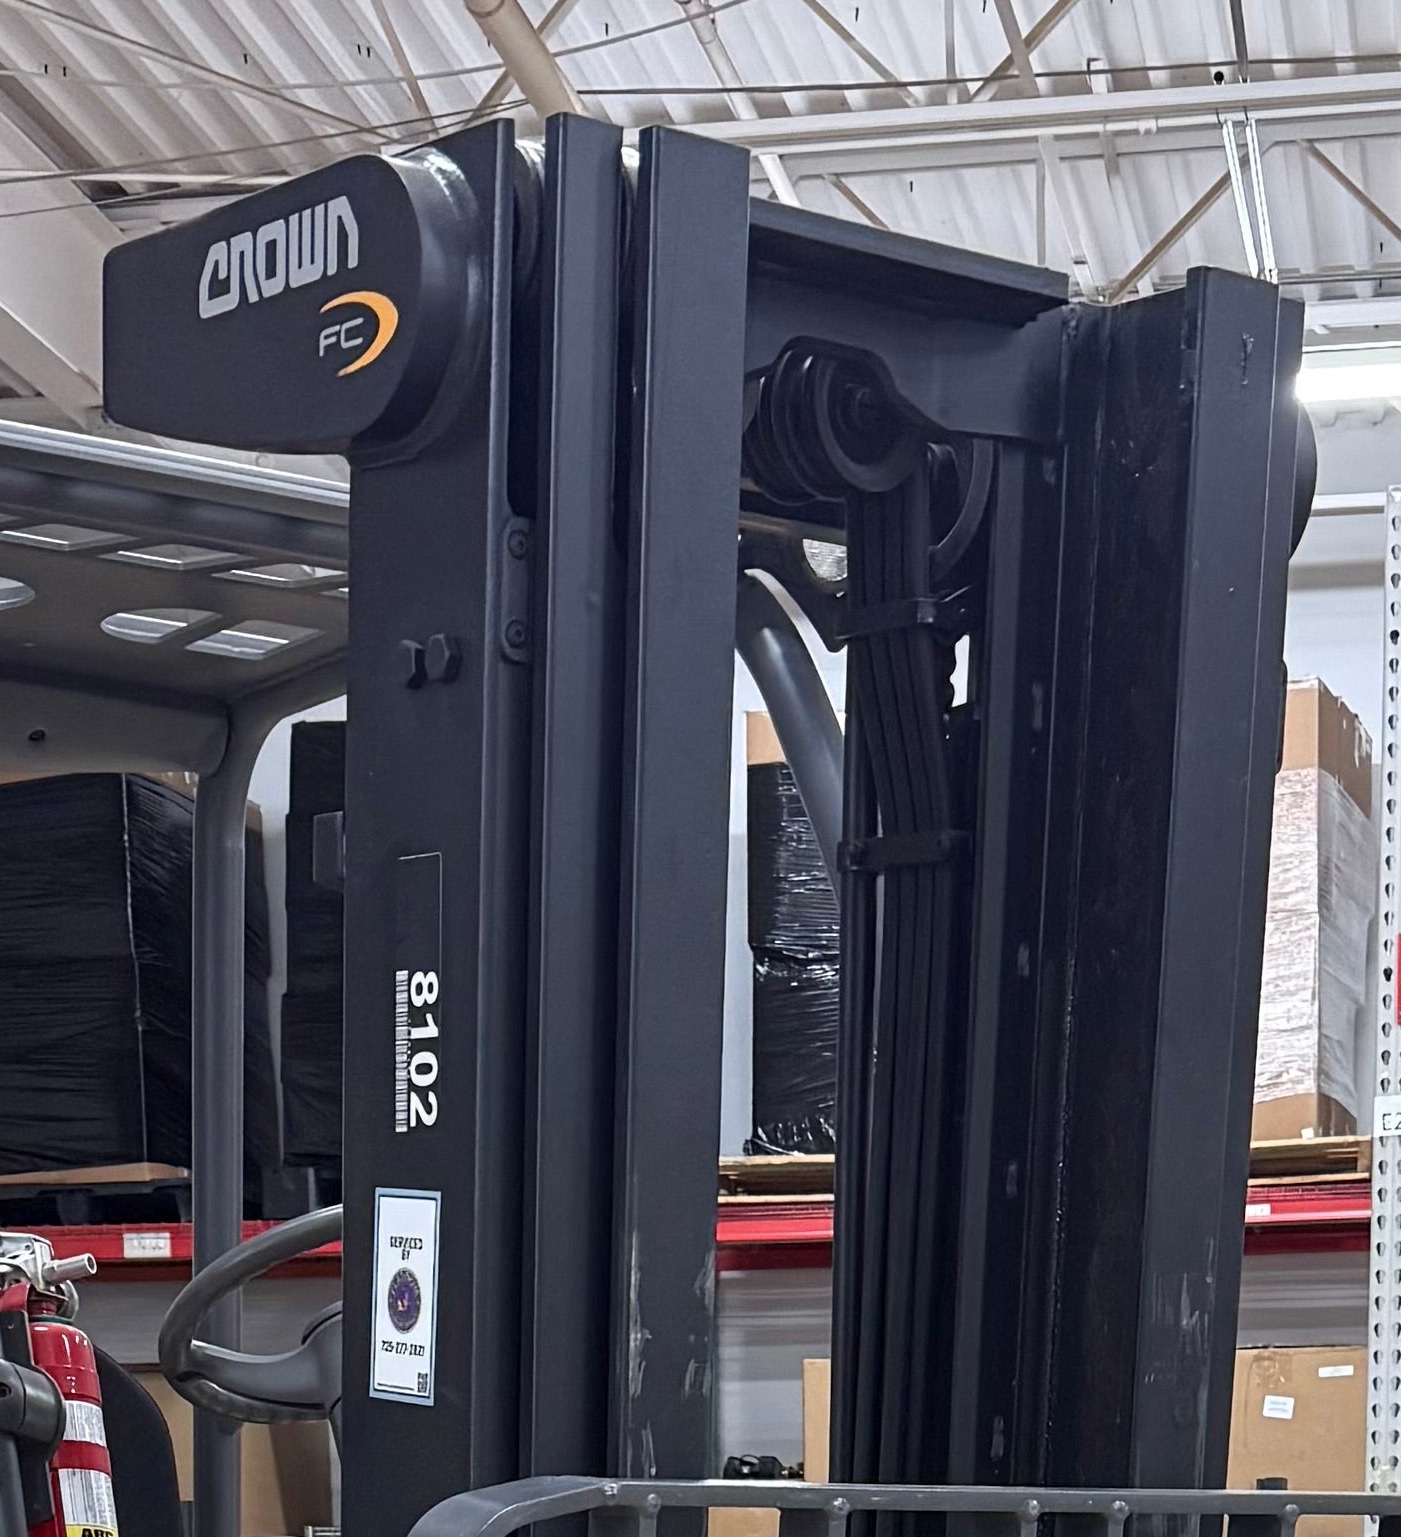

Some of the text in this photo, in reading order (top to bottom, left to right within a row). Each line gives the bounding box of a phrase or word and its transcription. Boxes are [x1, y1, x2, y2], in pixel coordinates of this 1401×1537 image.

[199, 195, 359, 319] CROWN
[319, 317, 365, 357] FC
[410, 970, 439, 1128] 8102
